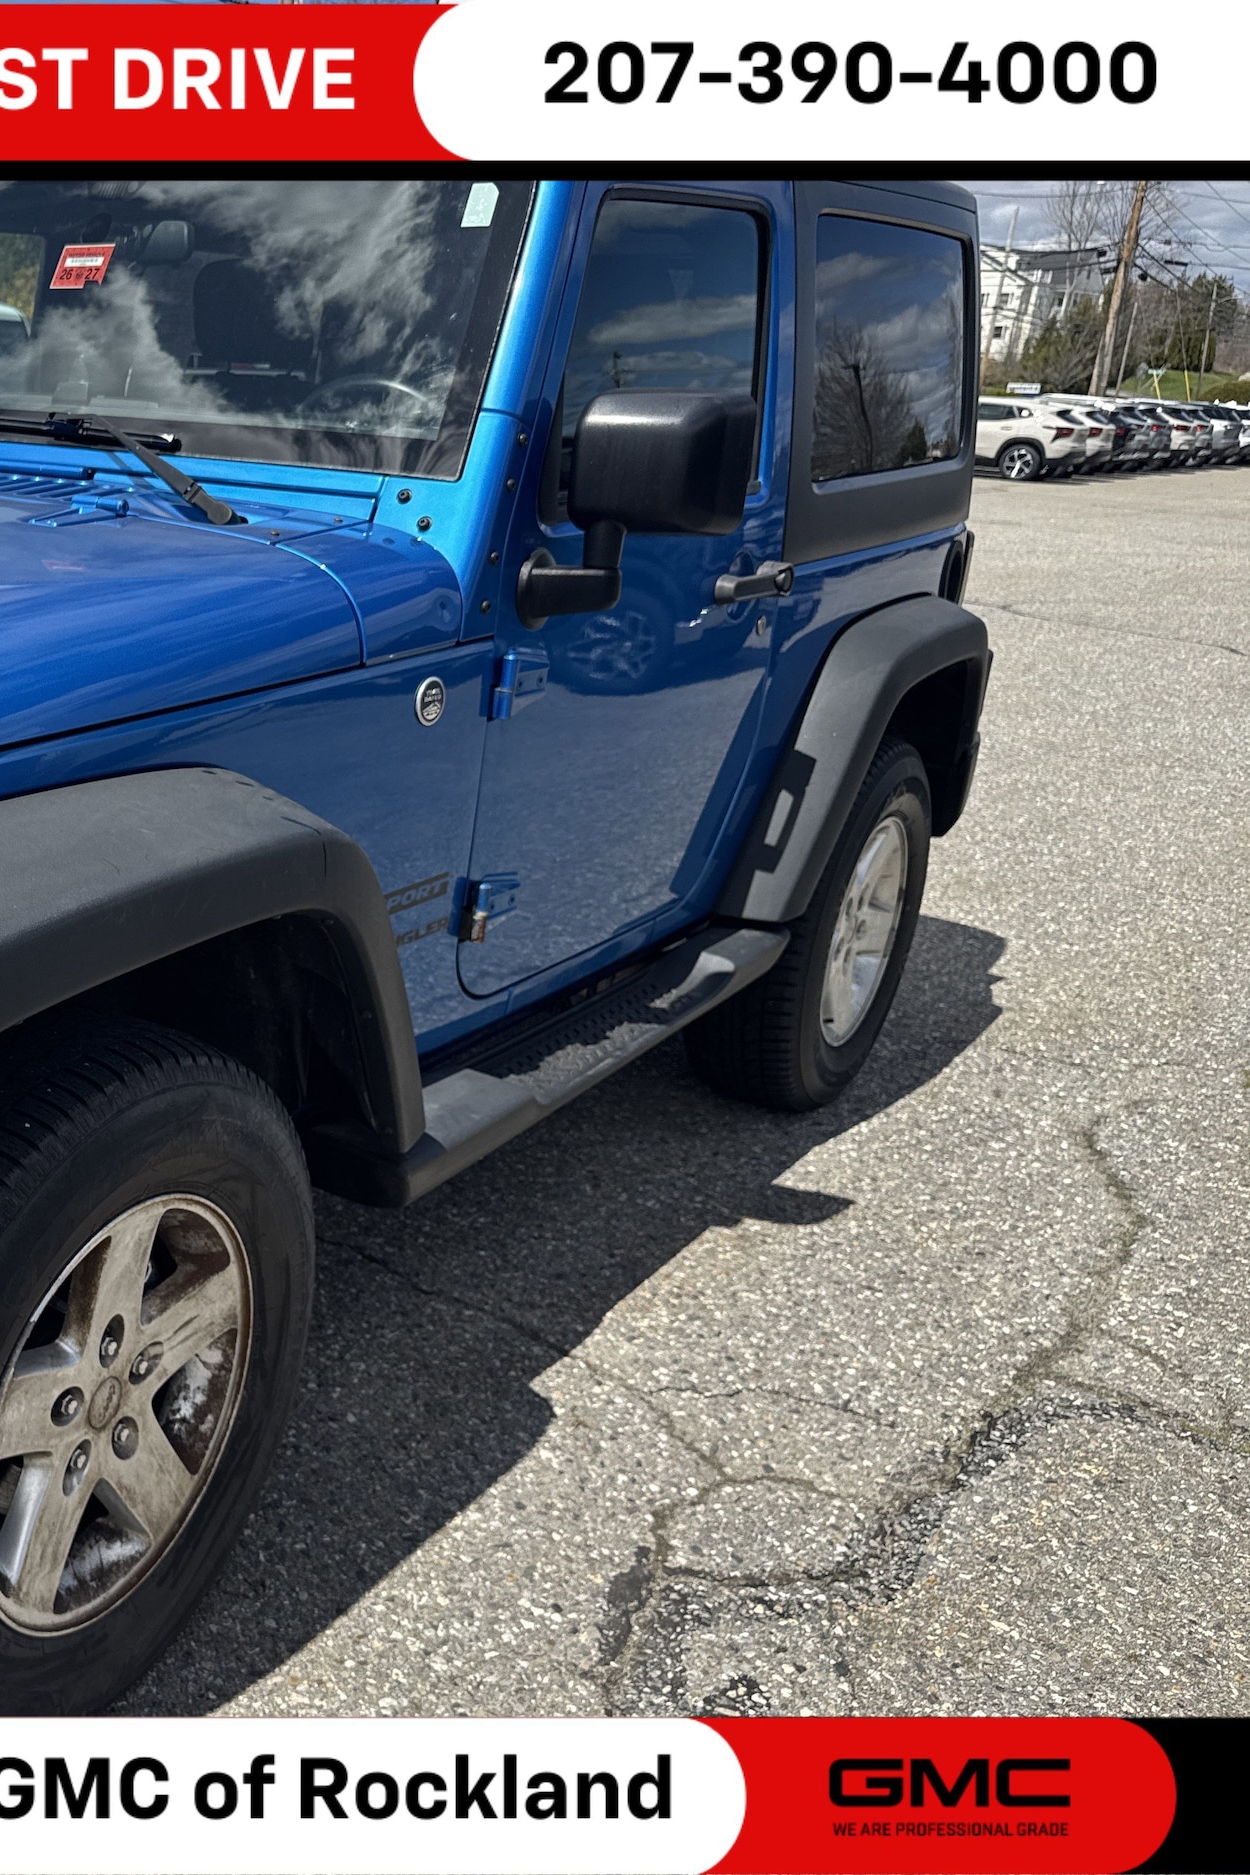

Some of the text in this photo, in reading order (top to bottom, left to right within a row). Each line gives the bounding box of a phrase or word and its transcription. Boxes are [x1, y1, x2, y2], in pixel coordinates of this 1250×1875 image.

[59, 269, 73, 280] 26
[85, 268, 100, 280] 27
[385, 879, 450, 910] PORT
[395, 916, 449, 946] GLER
